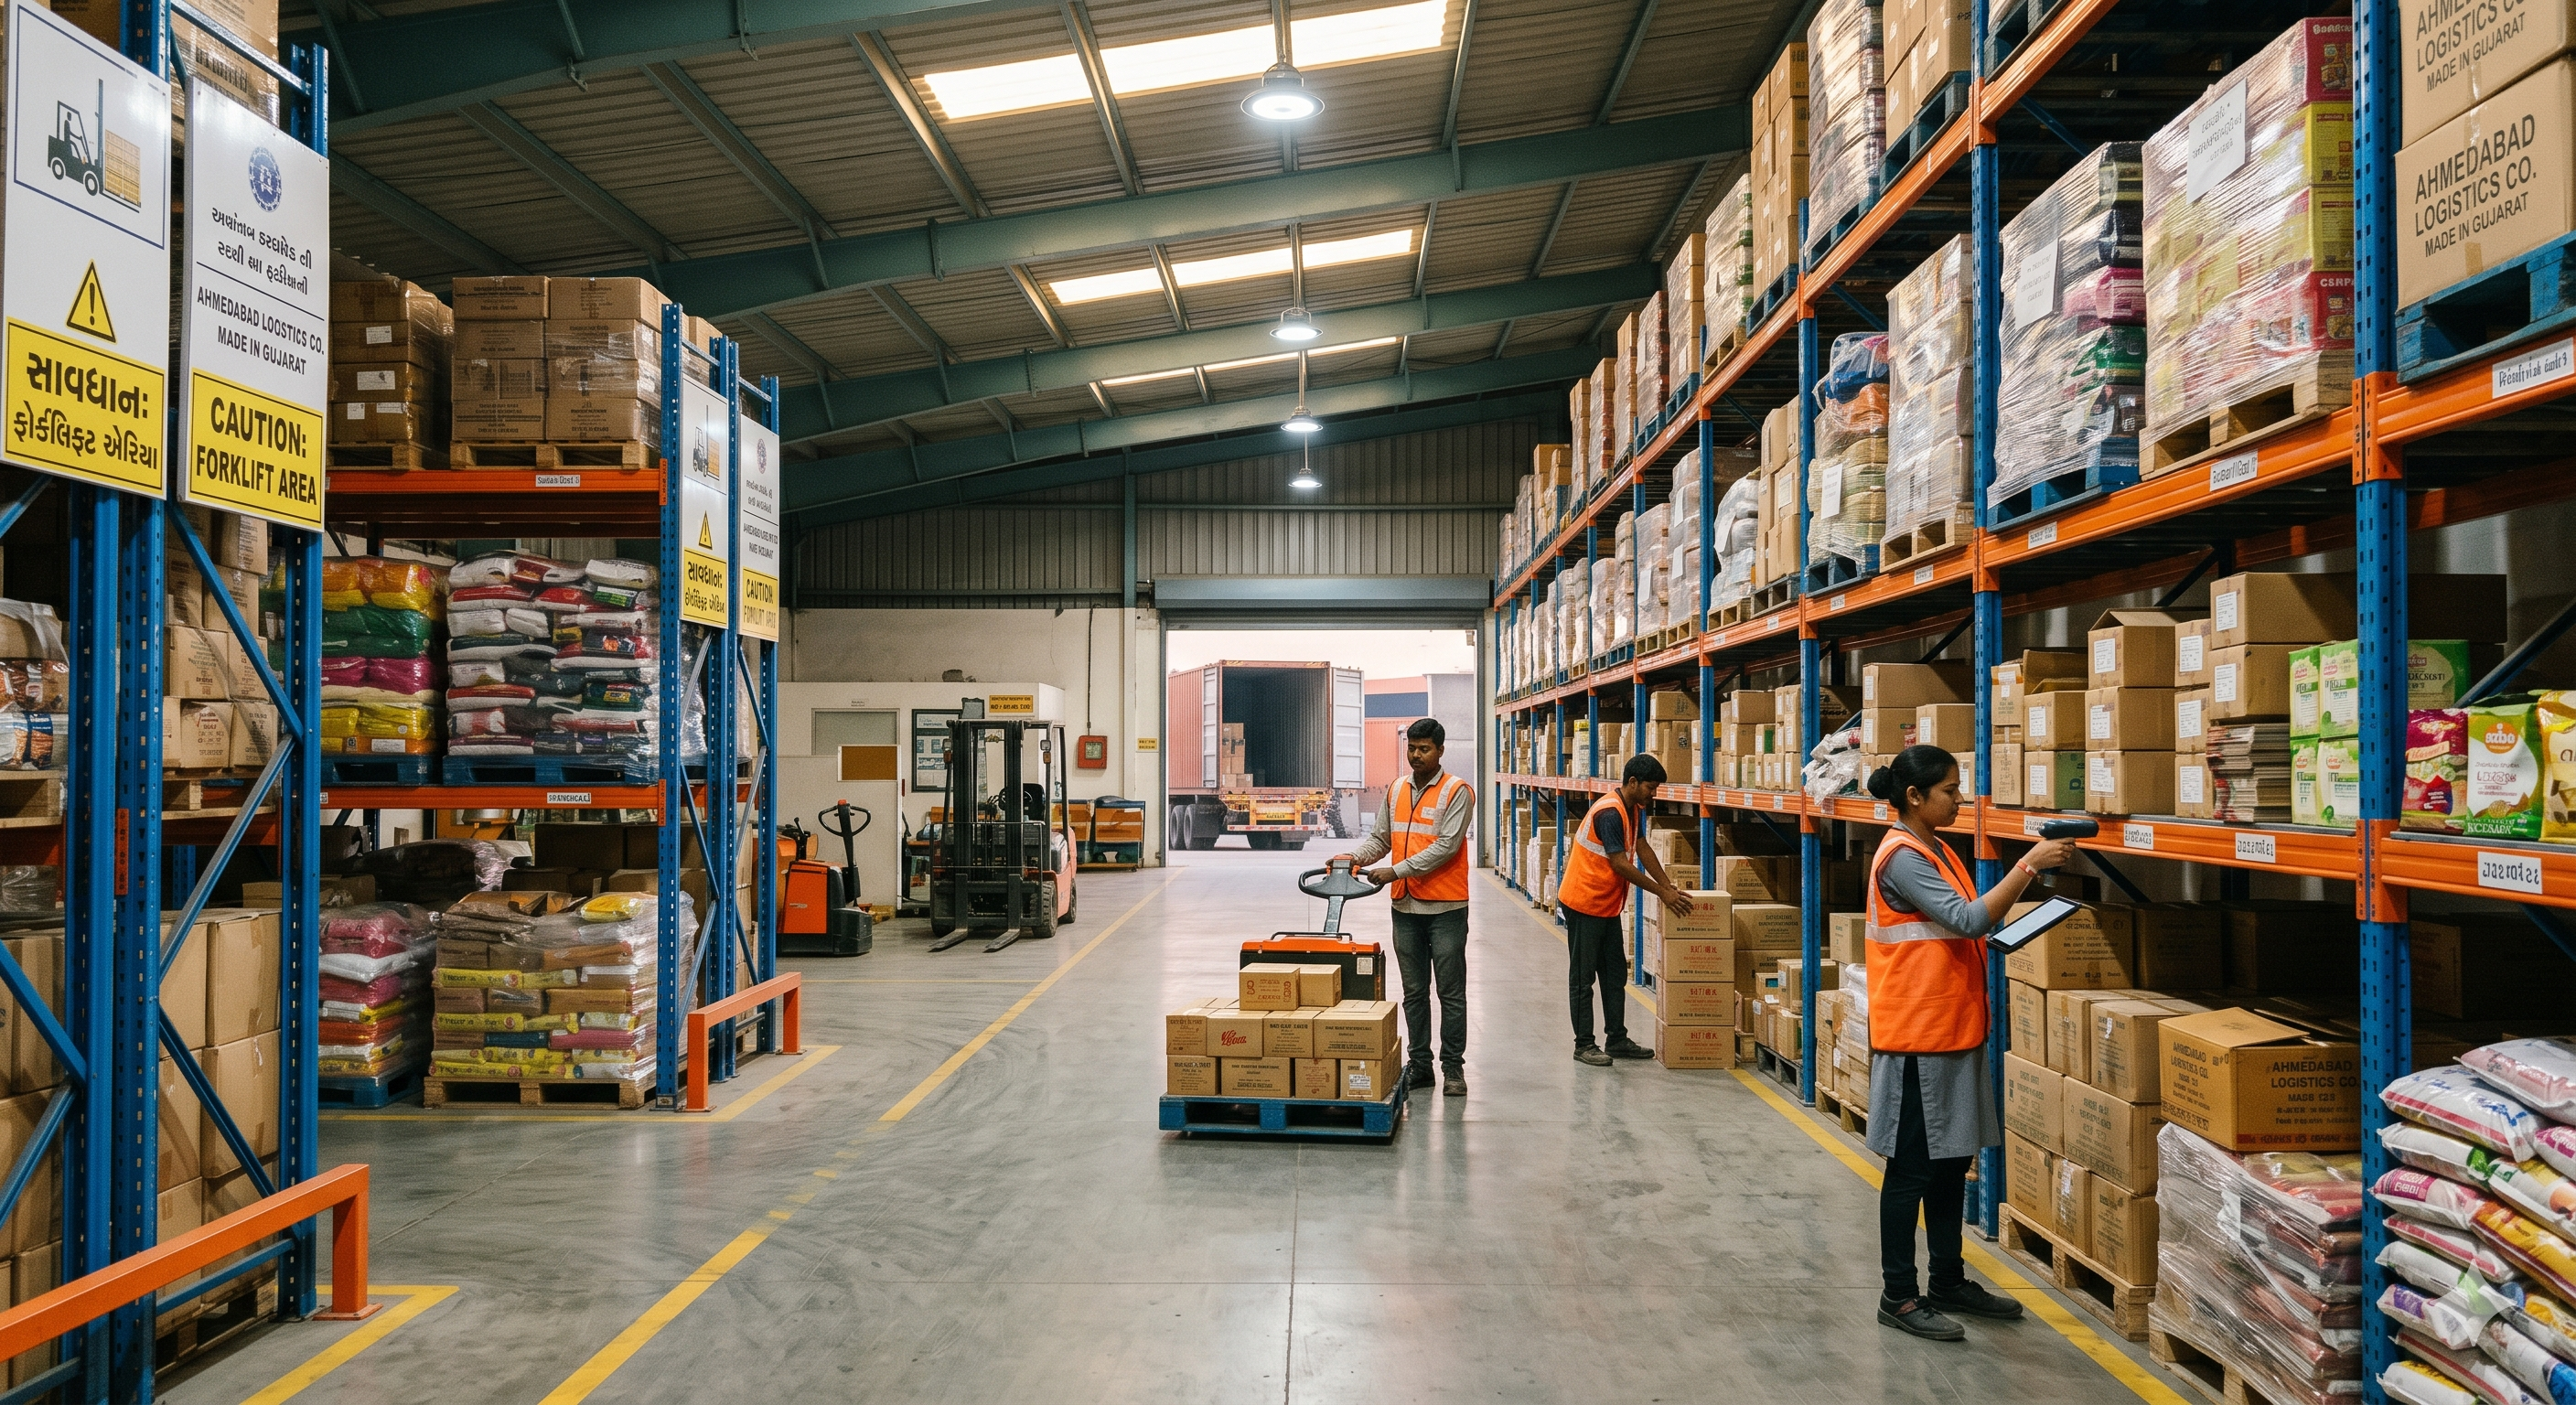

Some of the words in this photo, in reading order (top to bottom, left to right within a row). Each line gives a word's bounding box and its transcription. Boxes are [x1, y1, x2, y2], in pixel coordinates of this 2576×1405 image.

[2417, 0, 2497, 73] LOGISTICS
[2427, 58, 2457, 92] MADE
[2459, 48, 2470, 71] IN
[2473, 11, 2526, 61] GUJARAT
[2415, 113, 2535, 205] AHMEDABAD
[2415, 171, 2500, 237] LOGISTICS
[2506, 156, 2537, 190] CO.
[2425, 227, 2456, 258] MADE
[2459, 220, 2470, 241] IN
[2472, 191, 2528, 233] GUJARAT
[197, 285, 260, 327] AHMEDABAD
[309, 334, 325, 355] CO.
[218, 325, 247, 354] MADE
[250, 338, 261, 359] IN
[263, 344, 306, 376] GUJARAT
[103, 424, 157, 470] એરિયા
[210, 396, 306, 458] CAUTION:
[196, 444, 274, 494] FORKLIFT
[277, 467, 317, 506] AREA
[2270, 1076, 2334, 1089] LOGISTICS
[2271, 1060, 2353, 1073] AHMEDABAD
